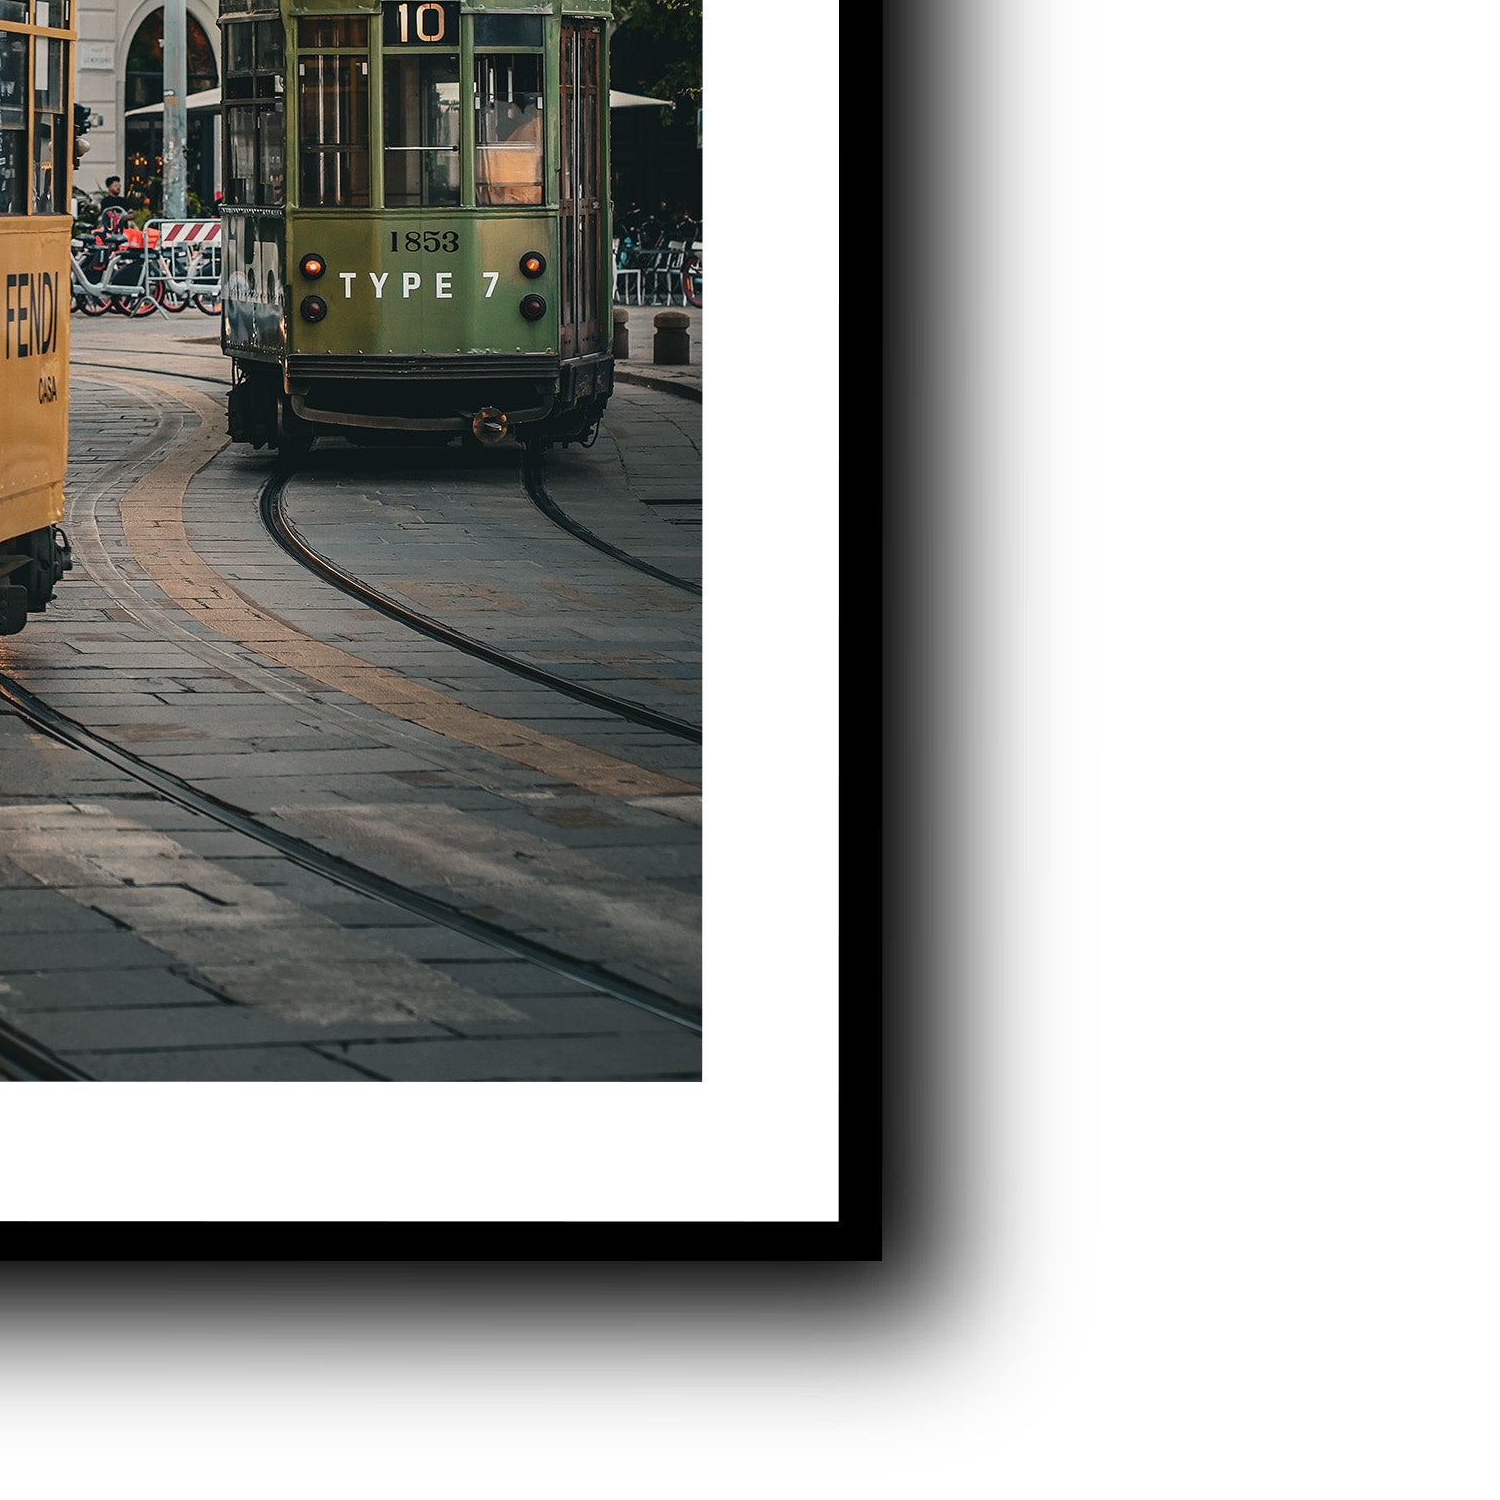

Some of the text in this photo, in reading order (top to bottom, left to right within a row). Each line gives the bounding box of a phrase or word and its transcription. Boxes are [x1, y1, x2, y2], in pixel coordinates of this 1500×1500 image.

[398, 3, 445, 43] 10
[390, 231, 460, 253] 1853
[339, 271, 500, 299] TYPE 7
[6, 271, 58, 360] FENDI
[38, 375, 58, 405] CASA
